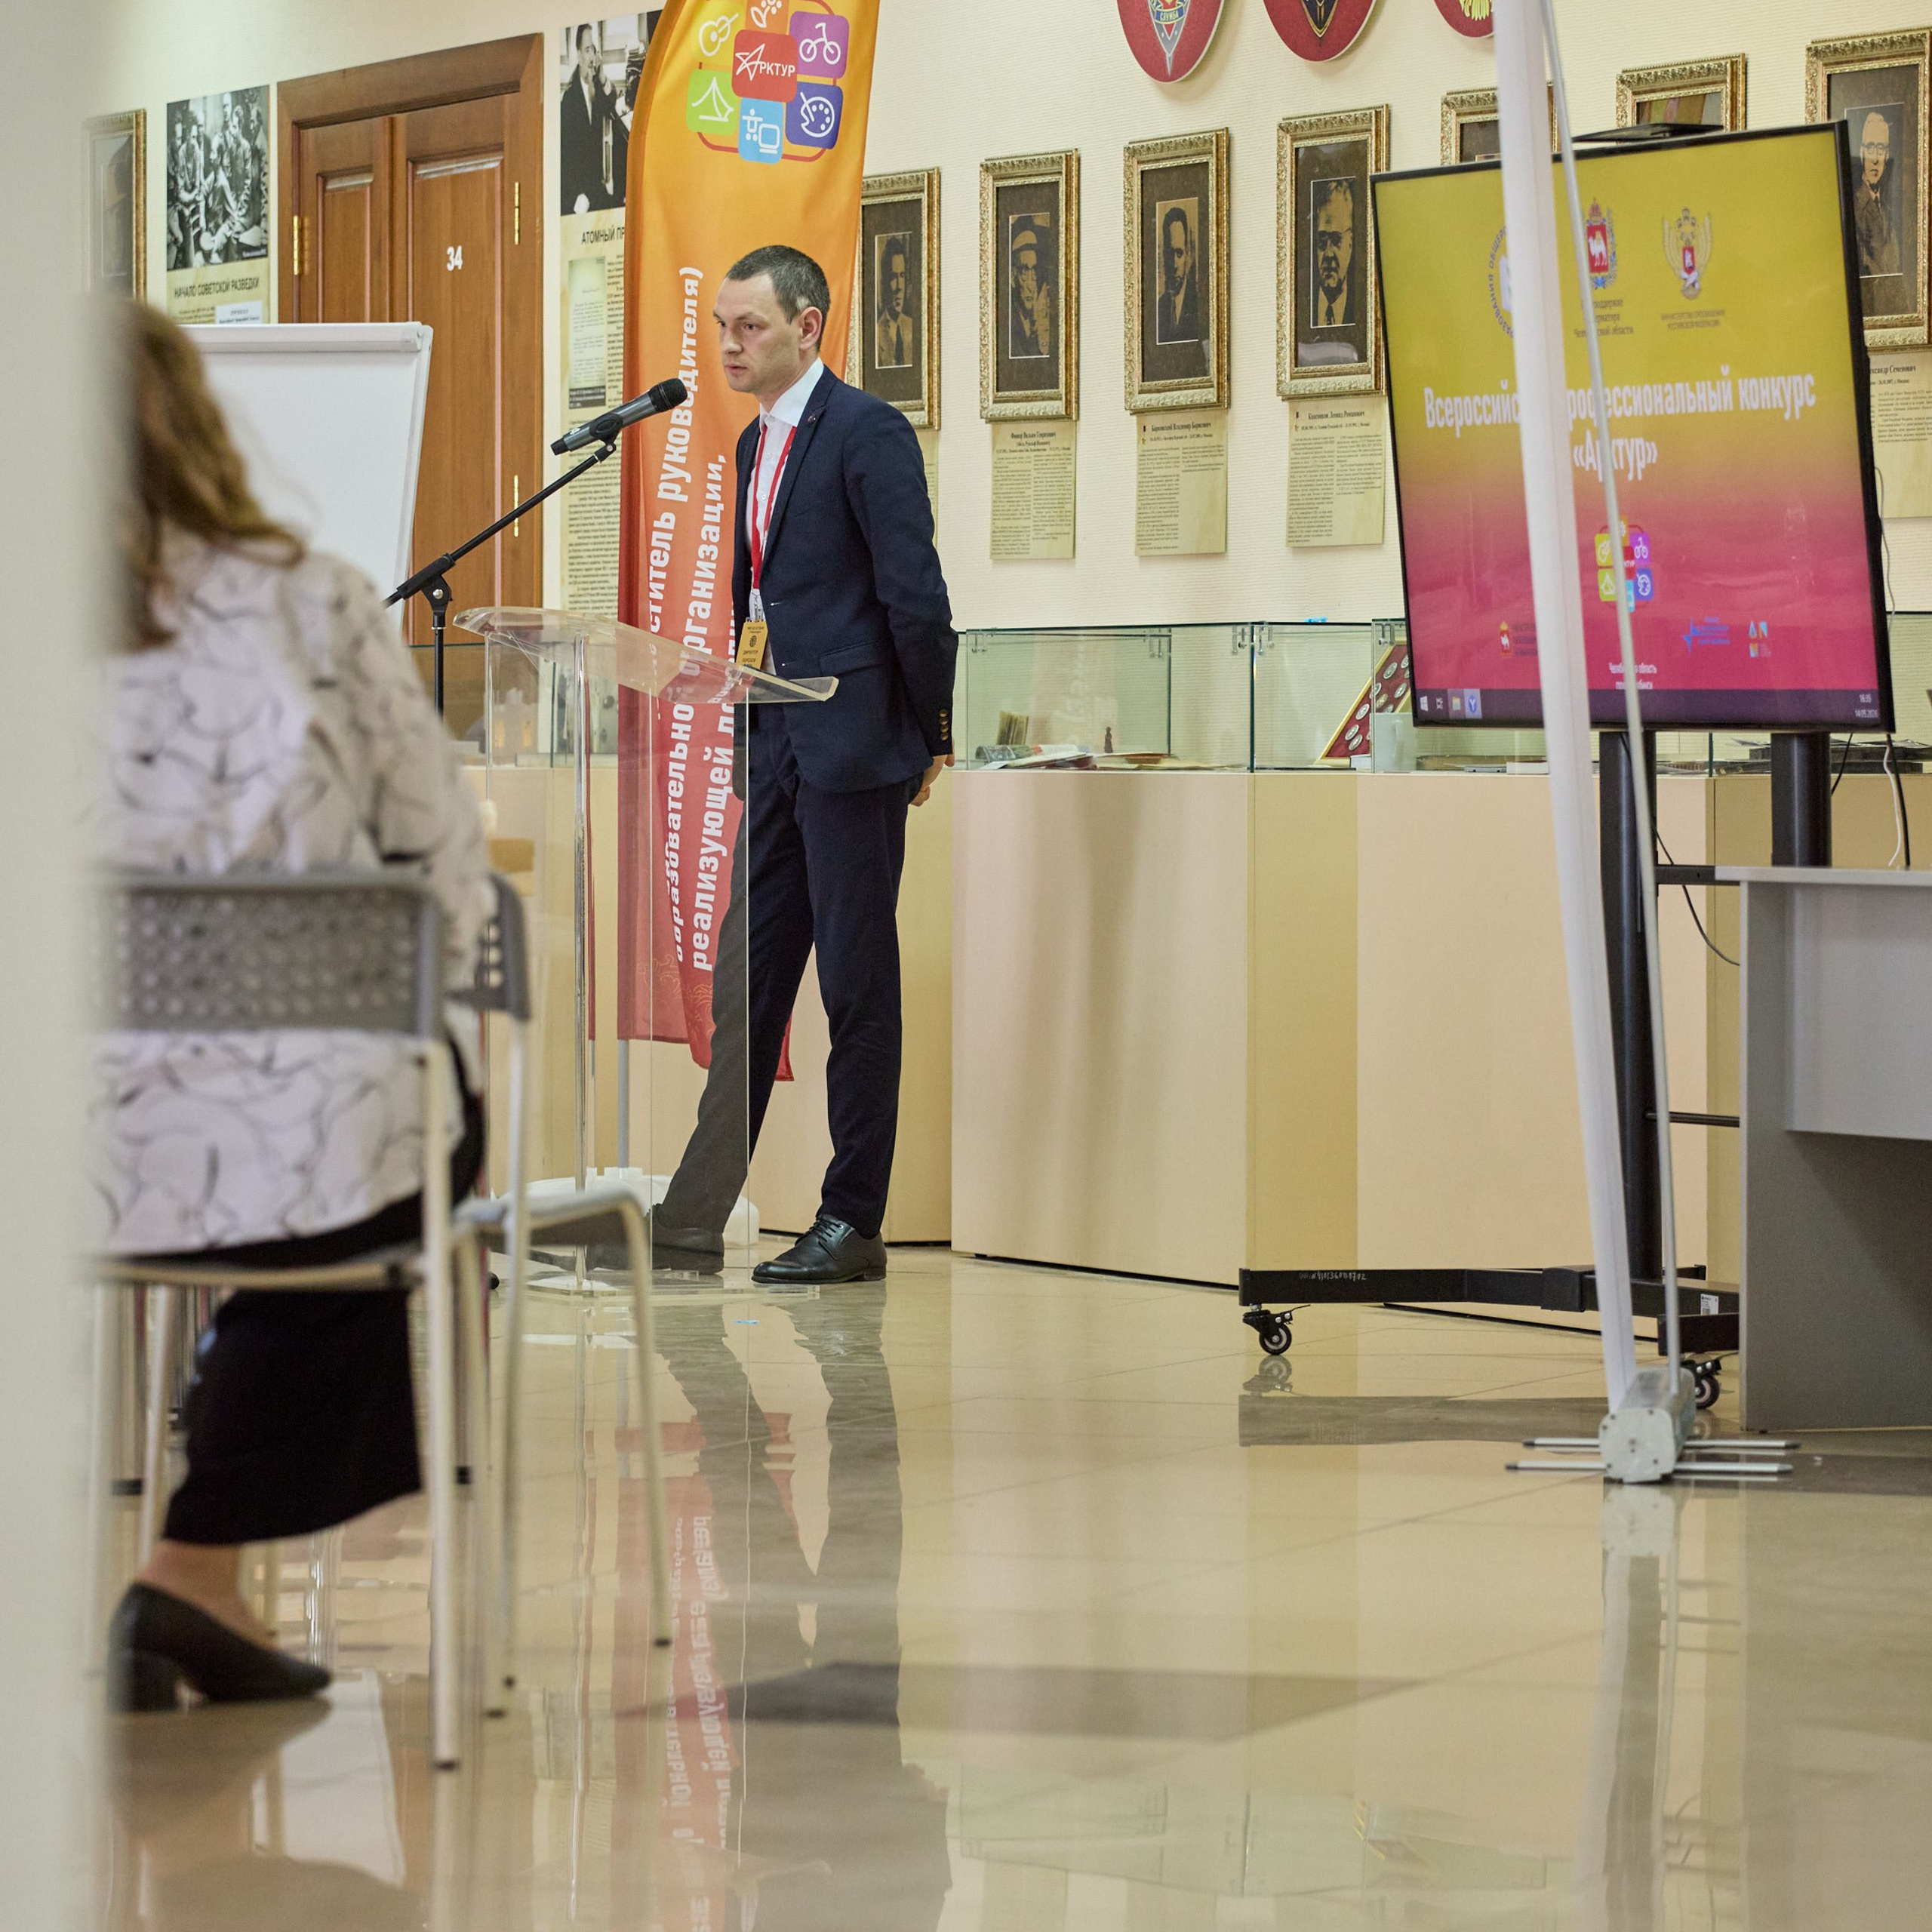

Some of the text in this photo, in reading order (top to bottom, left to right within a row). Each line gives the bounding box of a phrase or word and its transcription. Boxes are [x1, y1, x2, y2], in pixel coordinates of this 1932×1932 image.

[582, 224, 615, 245] АТОМНЫЙ
[447, 245, 463, 271] 34
[174, 276, 260, 298] НАЧАЛО СОВЕТСКОЙ РАЗВЕДКИ
[1889, 365, 1916, 374] Семенович
[1424, 380, 1520, 438] Всероссийс
[1567, 365, 1734, 431] роессиональный
[1739, 374, 1817, 420] конкурс
[692, 746, 734, 971] реализующей
